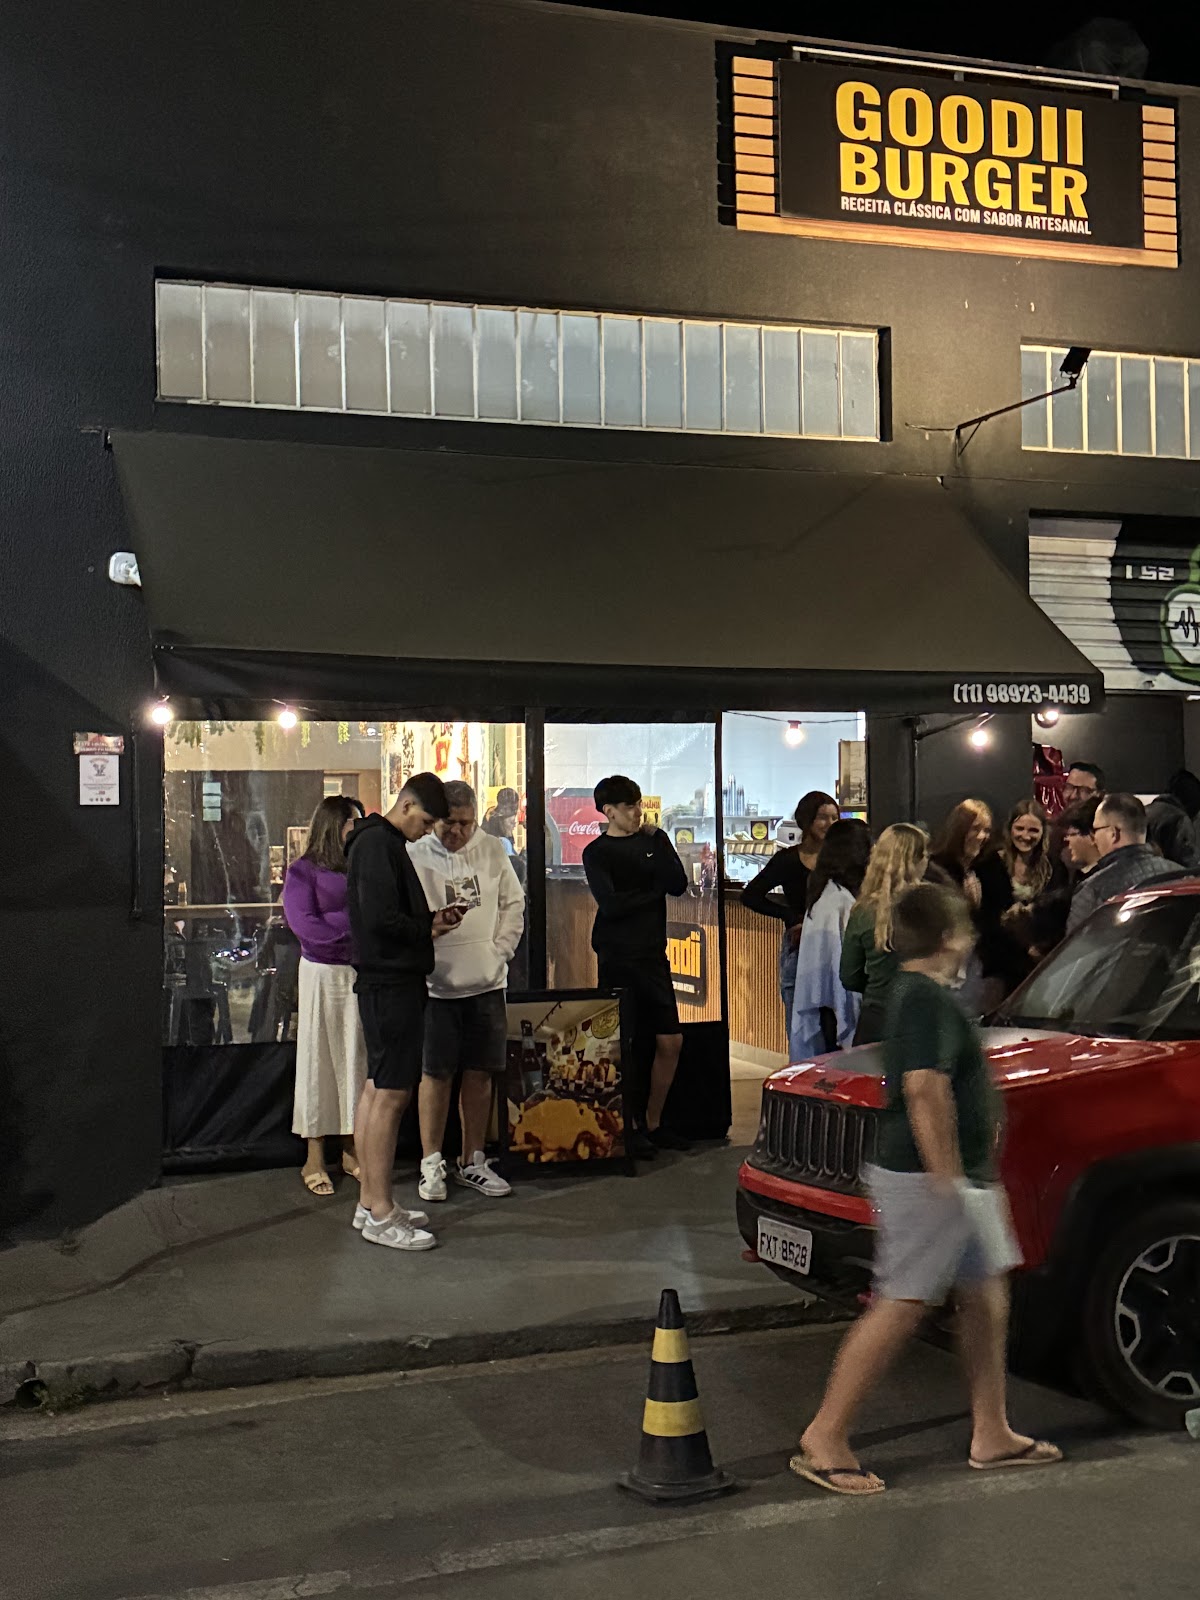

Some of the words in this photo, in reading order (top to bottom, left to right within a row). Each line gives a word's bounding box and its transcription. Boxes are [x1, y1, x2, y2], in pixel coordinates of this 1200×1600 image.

[835, 81, 1083, 165] GOODII
[840, 142, 1089, 218] BURGER
[841, 196, 891, 214] RECEITA
[894, 201, 952, 220] CLÁSSICA
[954, 208, 980, 224] COM
[983, 210, 1022, 228] SABOR
[1025, 215, 1092, 235] ARTESANAL
[953, 683, 983, 703] (11)
[985, 683, 1090, 704] 98923-4439
